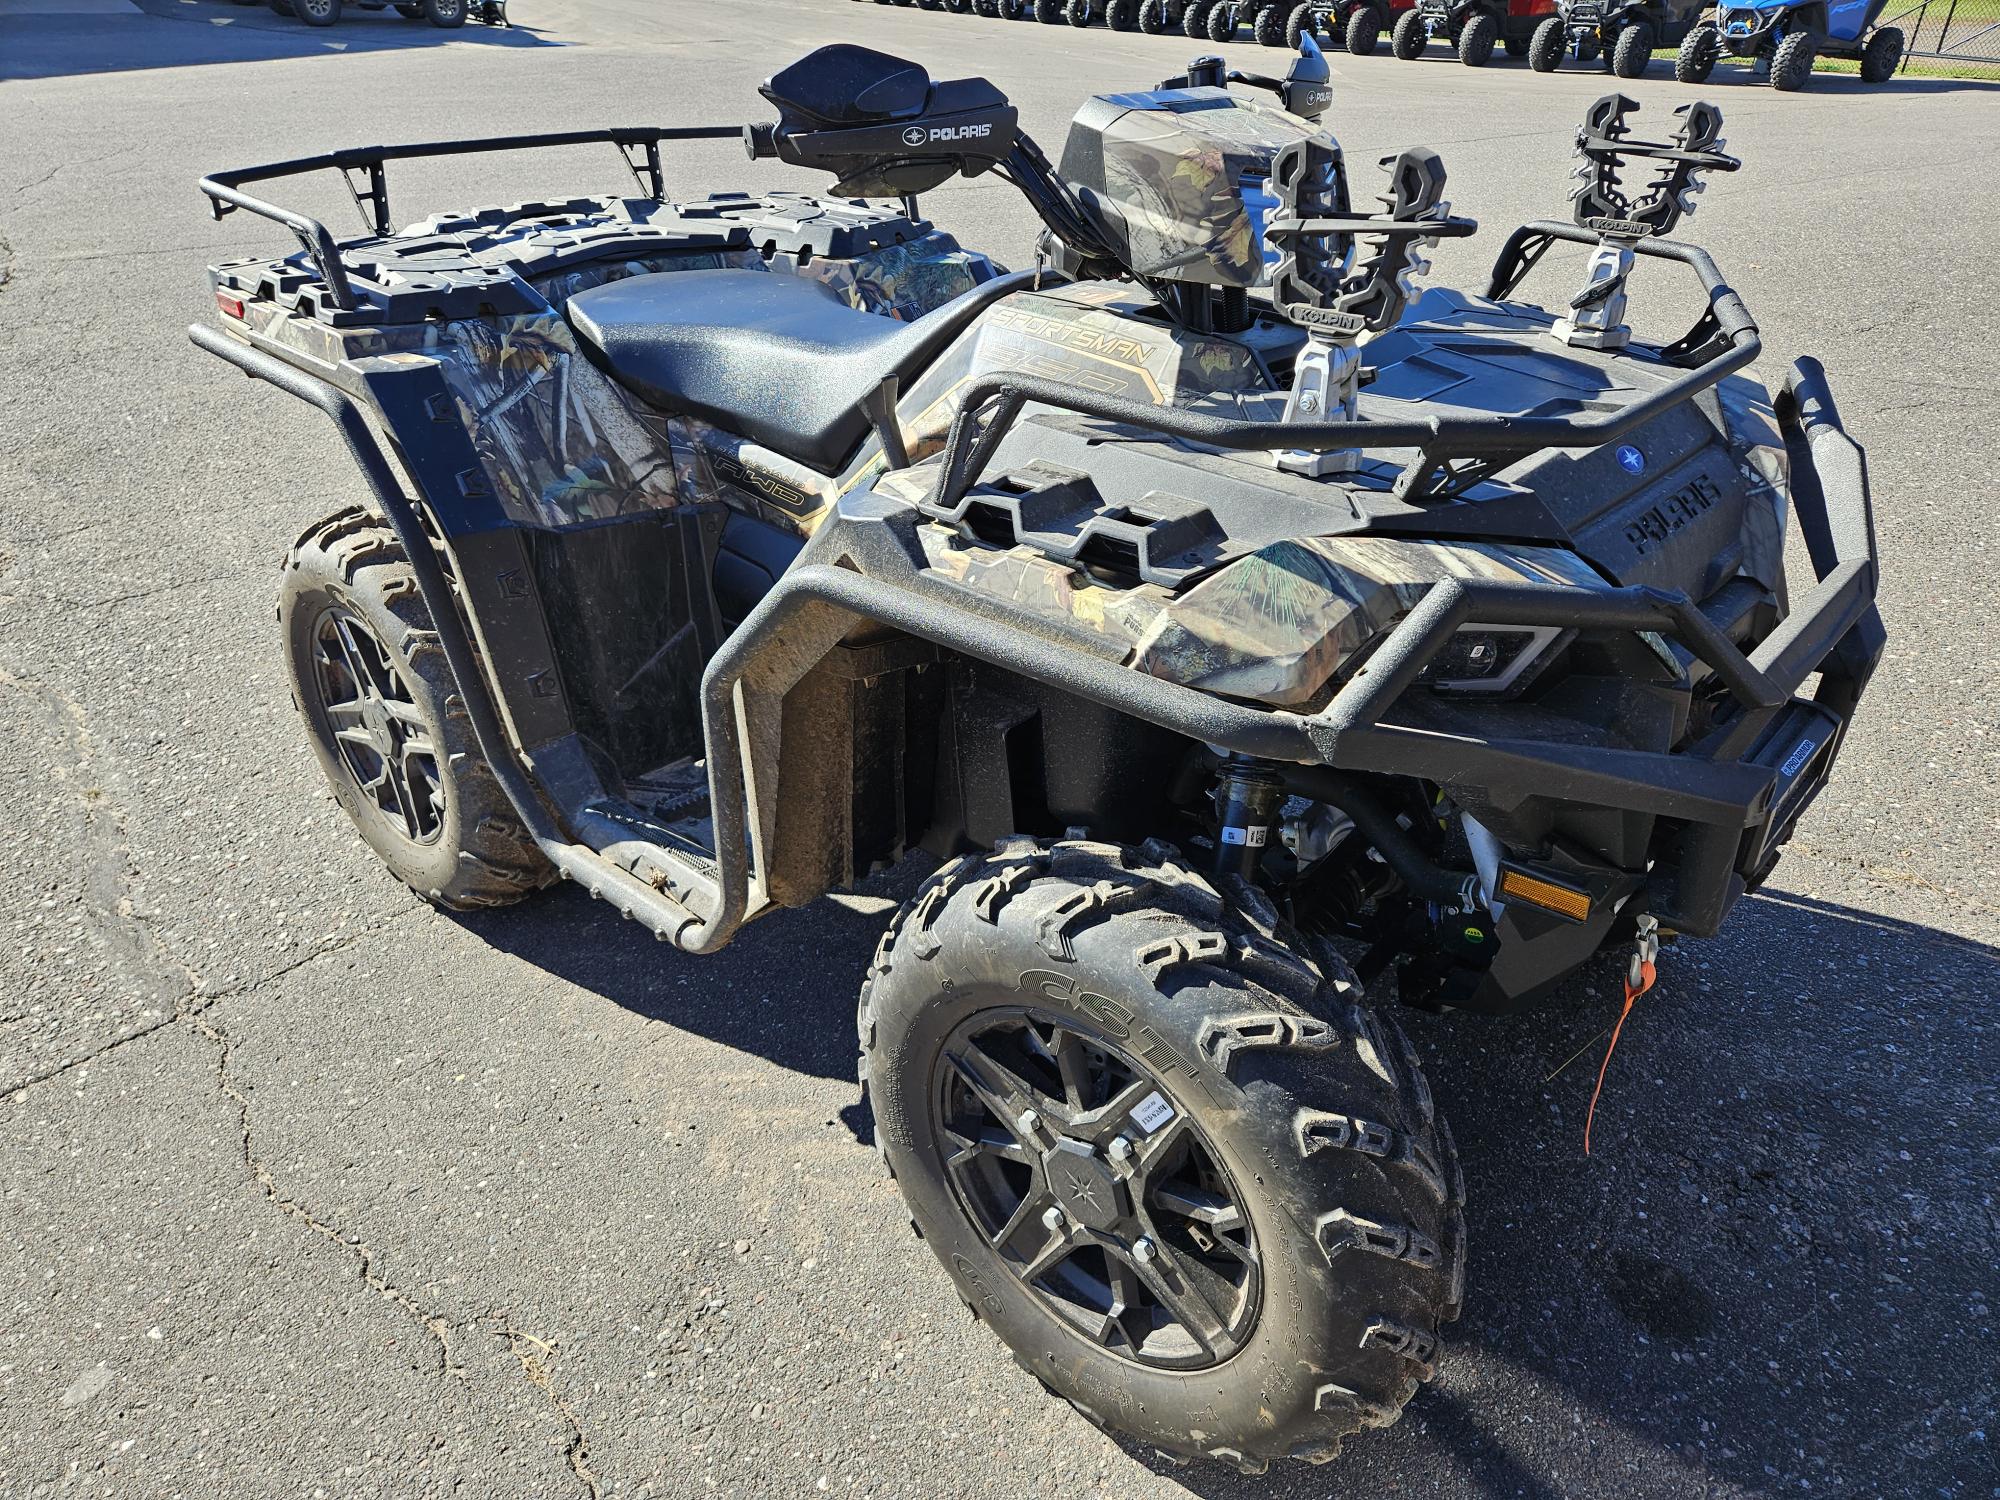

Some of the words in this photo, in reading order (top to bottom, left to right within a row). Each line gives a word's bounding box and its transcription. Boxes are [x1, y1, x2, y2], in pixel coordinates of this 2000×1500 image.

[929, 123, 993, 142] POLARIS
[1596, 219, 1643, 234] KOLPIN
[992, 307, 1159, 365] SPORTSMAN
[1299, 307, 1356, 329] KOLPIN
[713, 456, 806, 506] AWD
[1622, 473, 1722, 555] POLARIS
[1785, 757, 1800, 773] PRO
[1793, 740, 1814, 762] ARMOR
[1018, 968, 1200, 1080] CST
